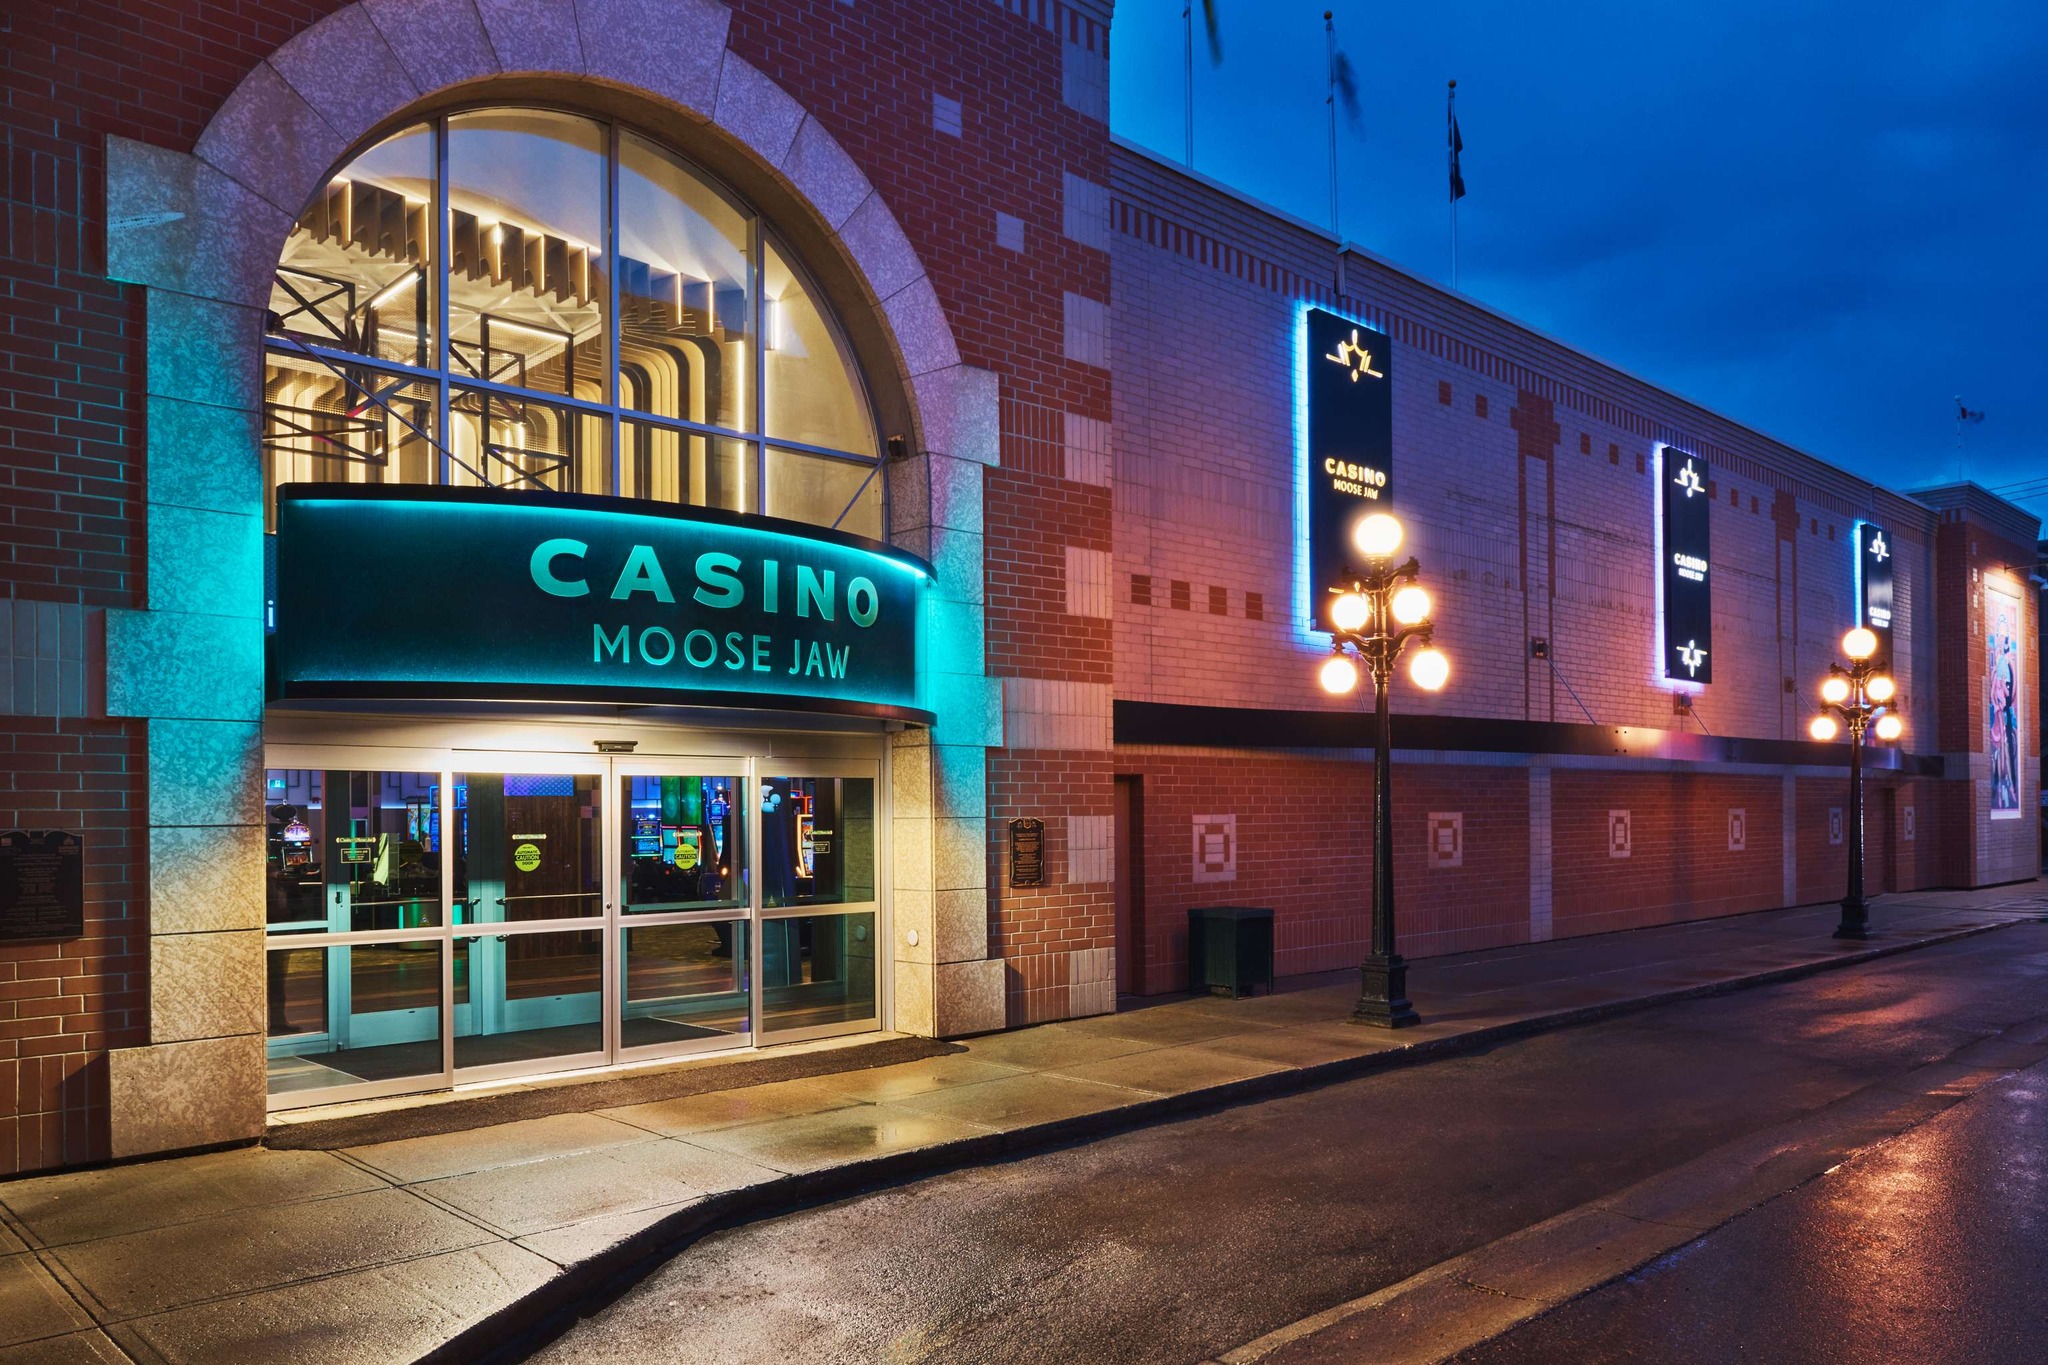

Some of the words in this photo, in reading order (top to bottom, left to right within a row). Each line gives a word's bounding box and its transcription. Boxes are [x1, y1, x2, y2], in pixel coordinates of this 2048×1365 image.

[1325, 458, 1386, 487] CASINO
[1333, 478, 1363, 496] MOOSE
[1363, 486, 1379, 500] JAW
[530, 538, 879, 628] CASINO
[593, 623, 771, 672] MOOSE
[788, 642, 850, 679] JAW
